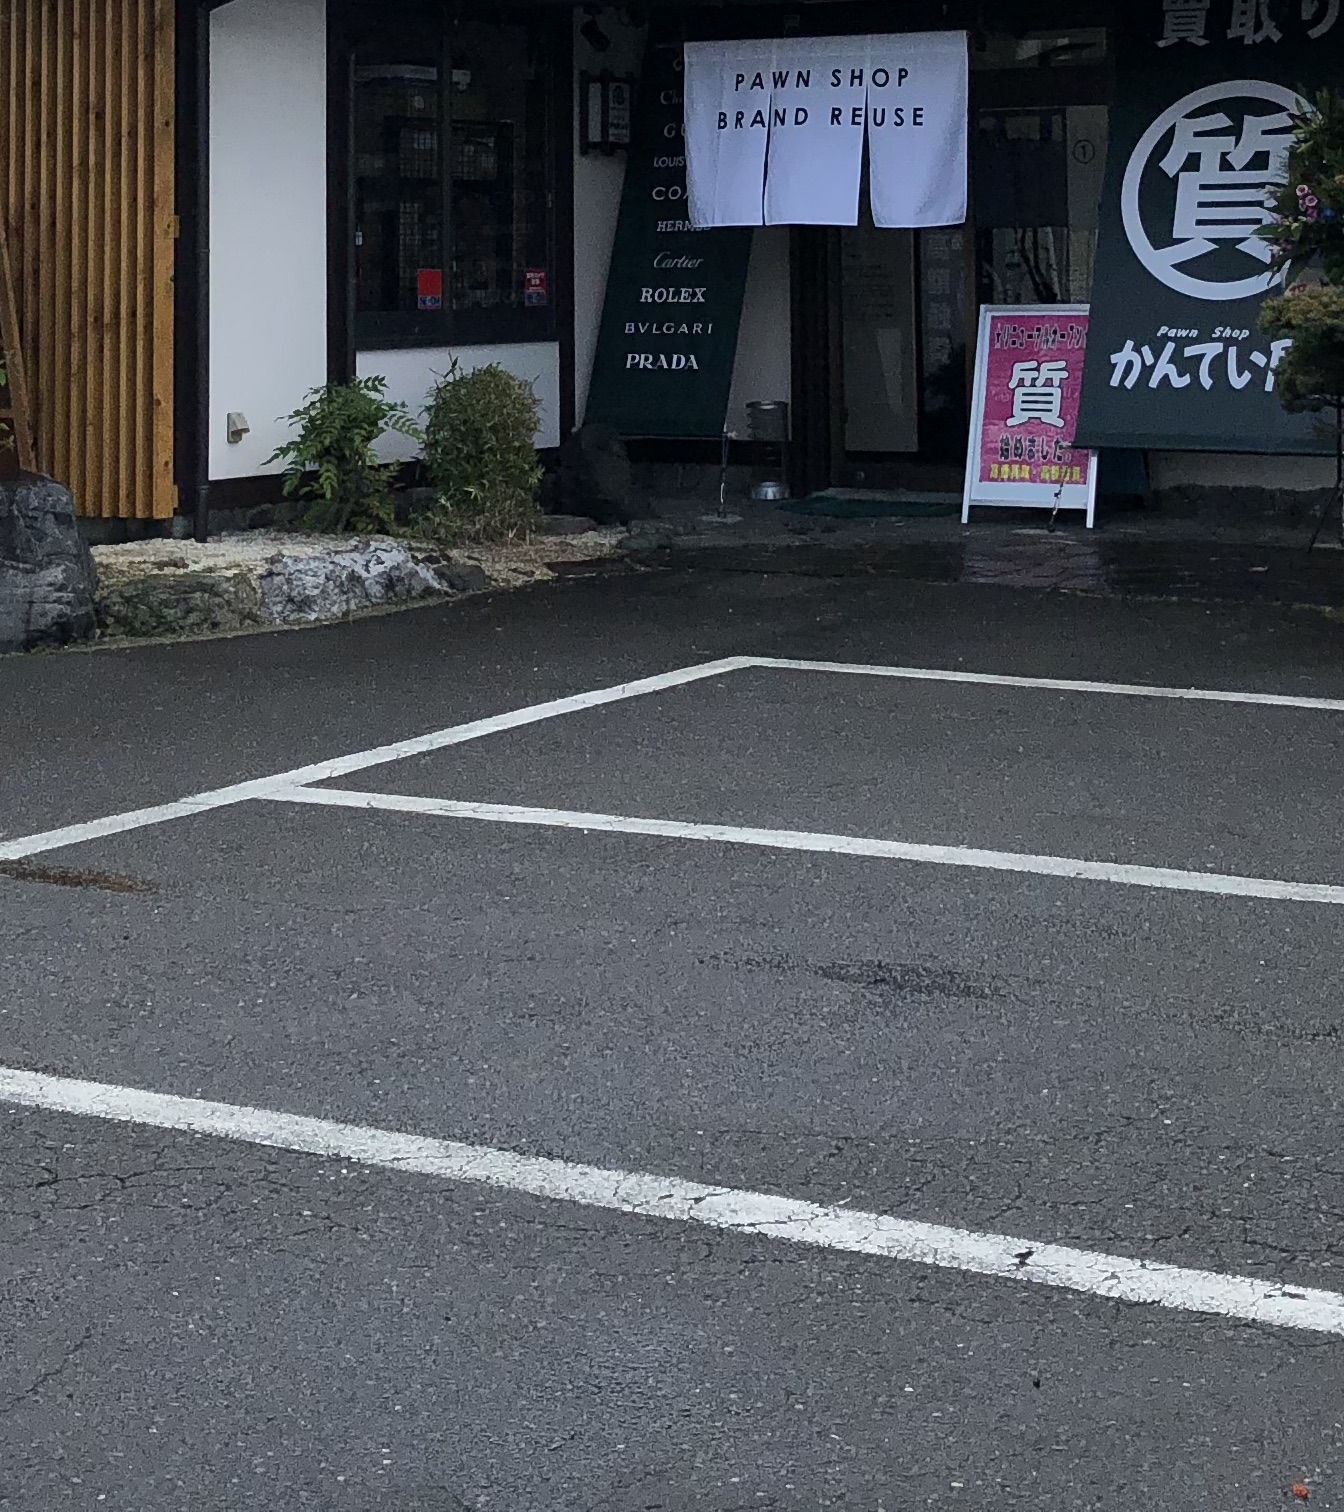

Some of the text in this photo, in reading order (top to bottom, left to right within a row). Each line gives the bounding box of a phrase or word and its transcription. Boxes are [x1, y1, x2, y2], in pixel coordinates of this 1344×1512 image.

[734, 67, 909, 91] PAWN SHOP
[717, 106, 924, 130] BRAND REUSE
[653, 251, 704, 268] Cartier
[639, 287, 707, 303] ROLEX
[624, 322, 713, 334] BVLGARI
[1156, 326, 1250, 340] Pawn Shop
[625, 353, 699, 370] PRADA
[1006, 360, 1069, 428] 質
